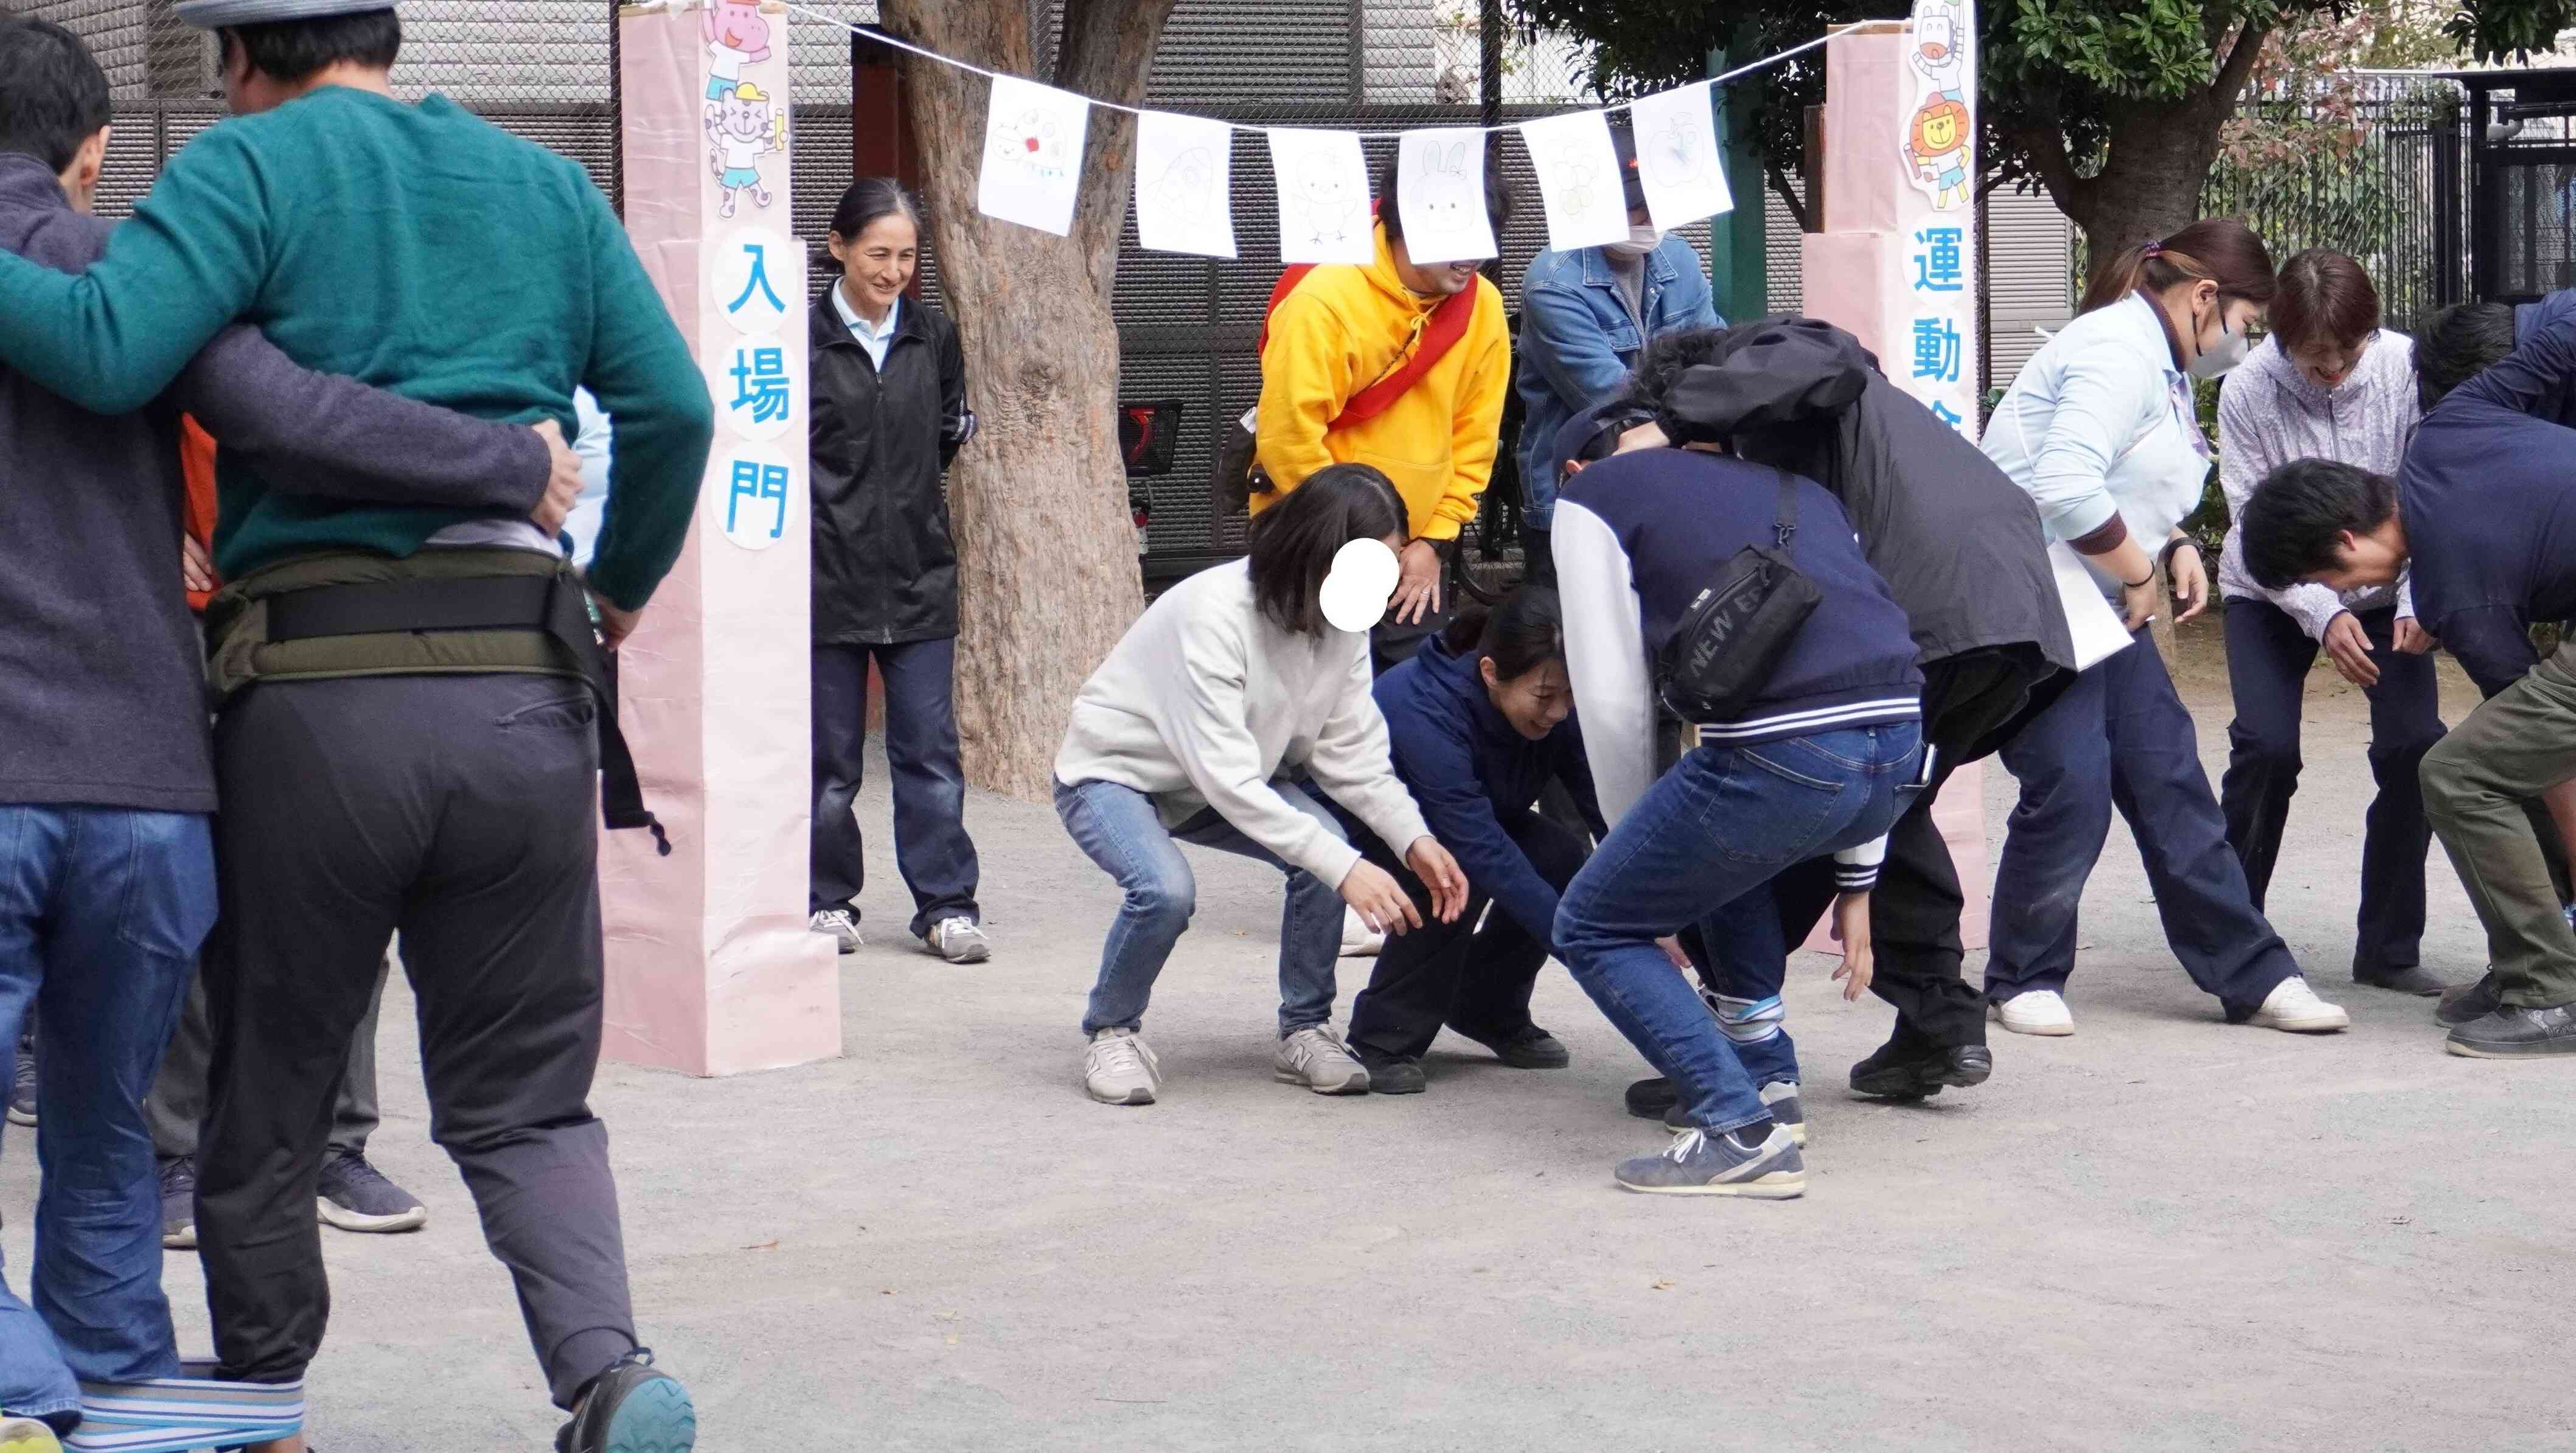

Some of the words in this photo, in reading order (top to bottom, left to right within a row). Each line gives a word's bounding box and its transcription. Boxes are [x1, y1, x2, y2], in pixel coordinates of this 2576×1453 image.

[728, 245, 789, 538] 入場門
[1690, 608, 1733, 677] NEW
[1287, 1043, 1314, 1072] N
